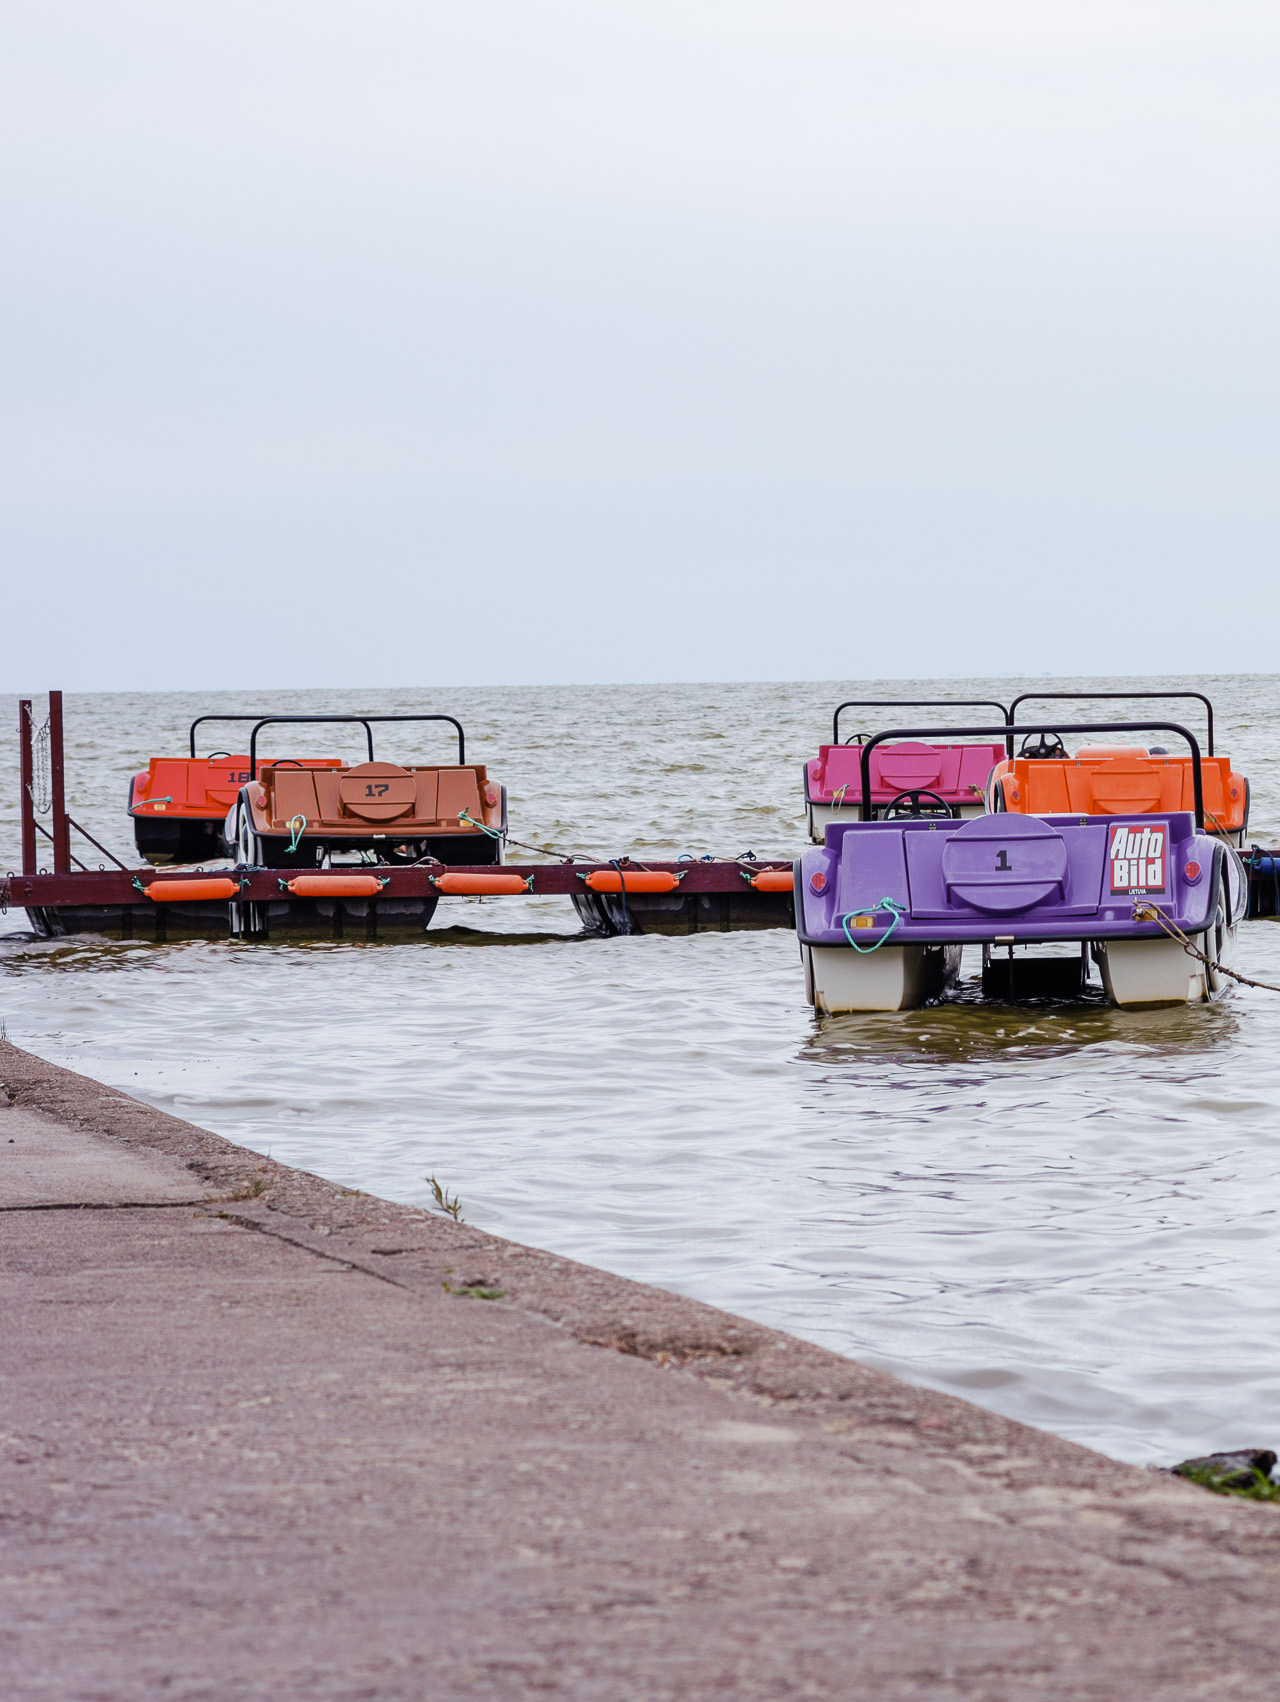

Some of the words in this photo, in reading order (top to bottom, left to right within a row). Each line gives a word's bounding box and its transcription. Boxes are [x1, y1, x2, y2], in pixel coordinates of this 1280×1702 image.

[227, 772, 251, 783] 18
[365, 784, 389, 797] 17
[1110, 827, 1164, 859] Auto
[995, 850, 1012, 871] 1
[1113, 858, 1162, 887] Bild
